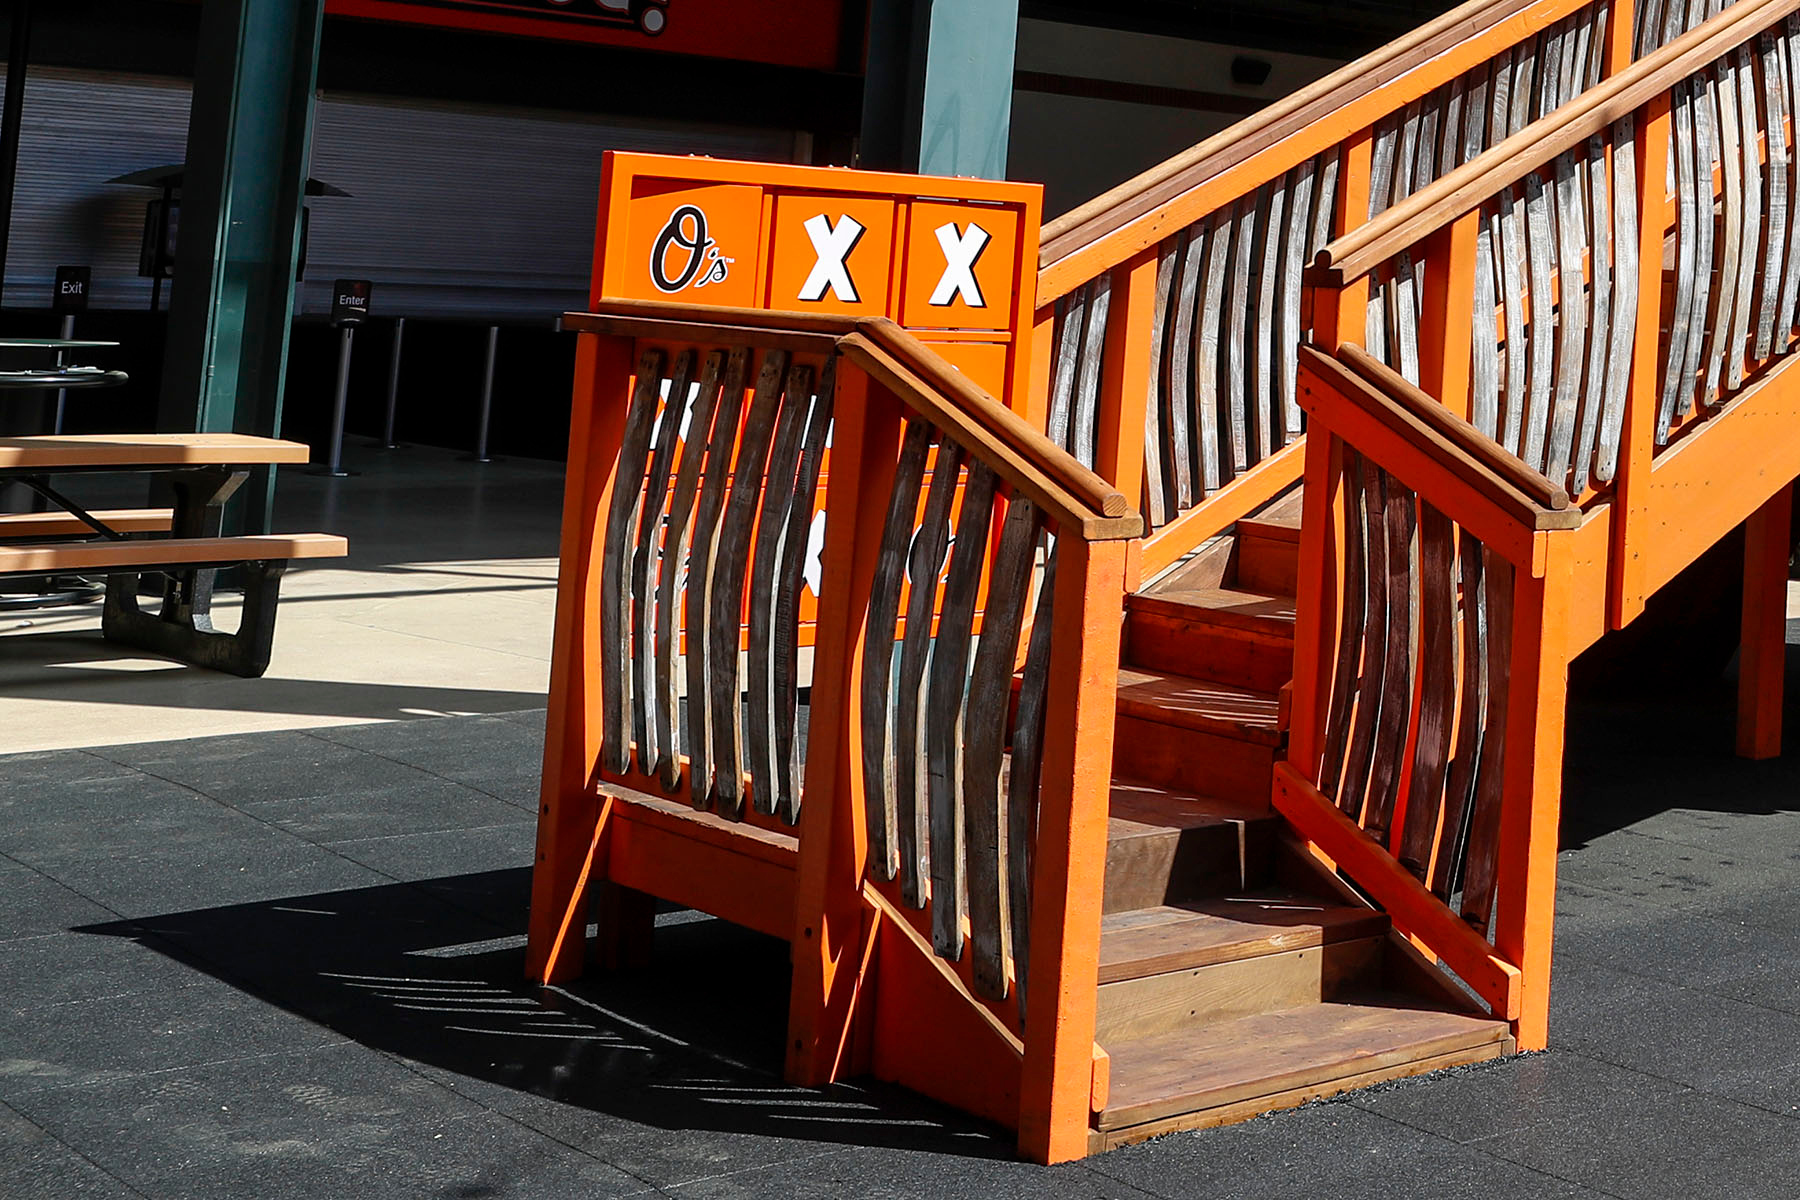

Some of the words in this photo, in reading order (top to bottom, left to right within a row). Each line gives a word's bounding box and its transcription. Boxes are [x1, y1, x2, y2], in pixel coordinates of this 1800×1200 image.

[797, 213, 866, 302] X
[928, 221, 992, 307] X
[61, 281, 83, 295] Exit
[339, 295, 365, 306] Enter
